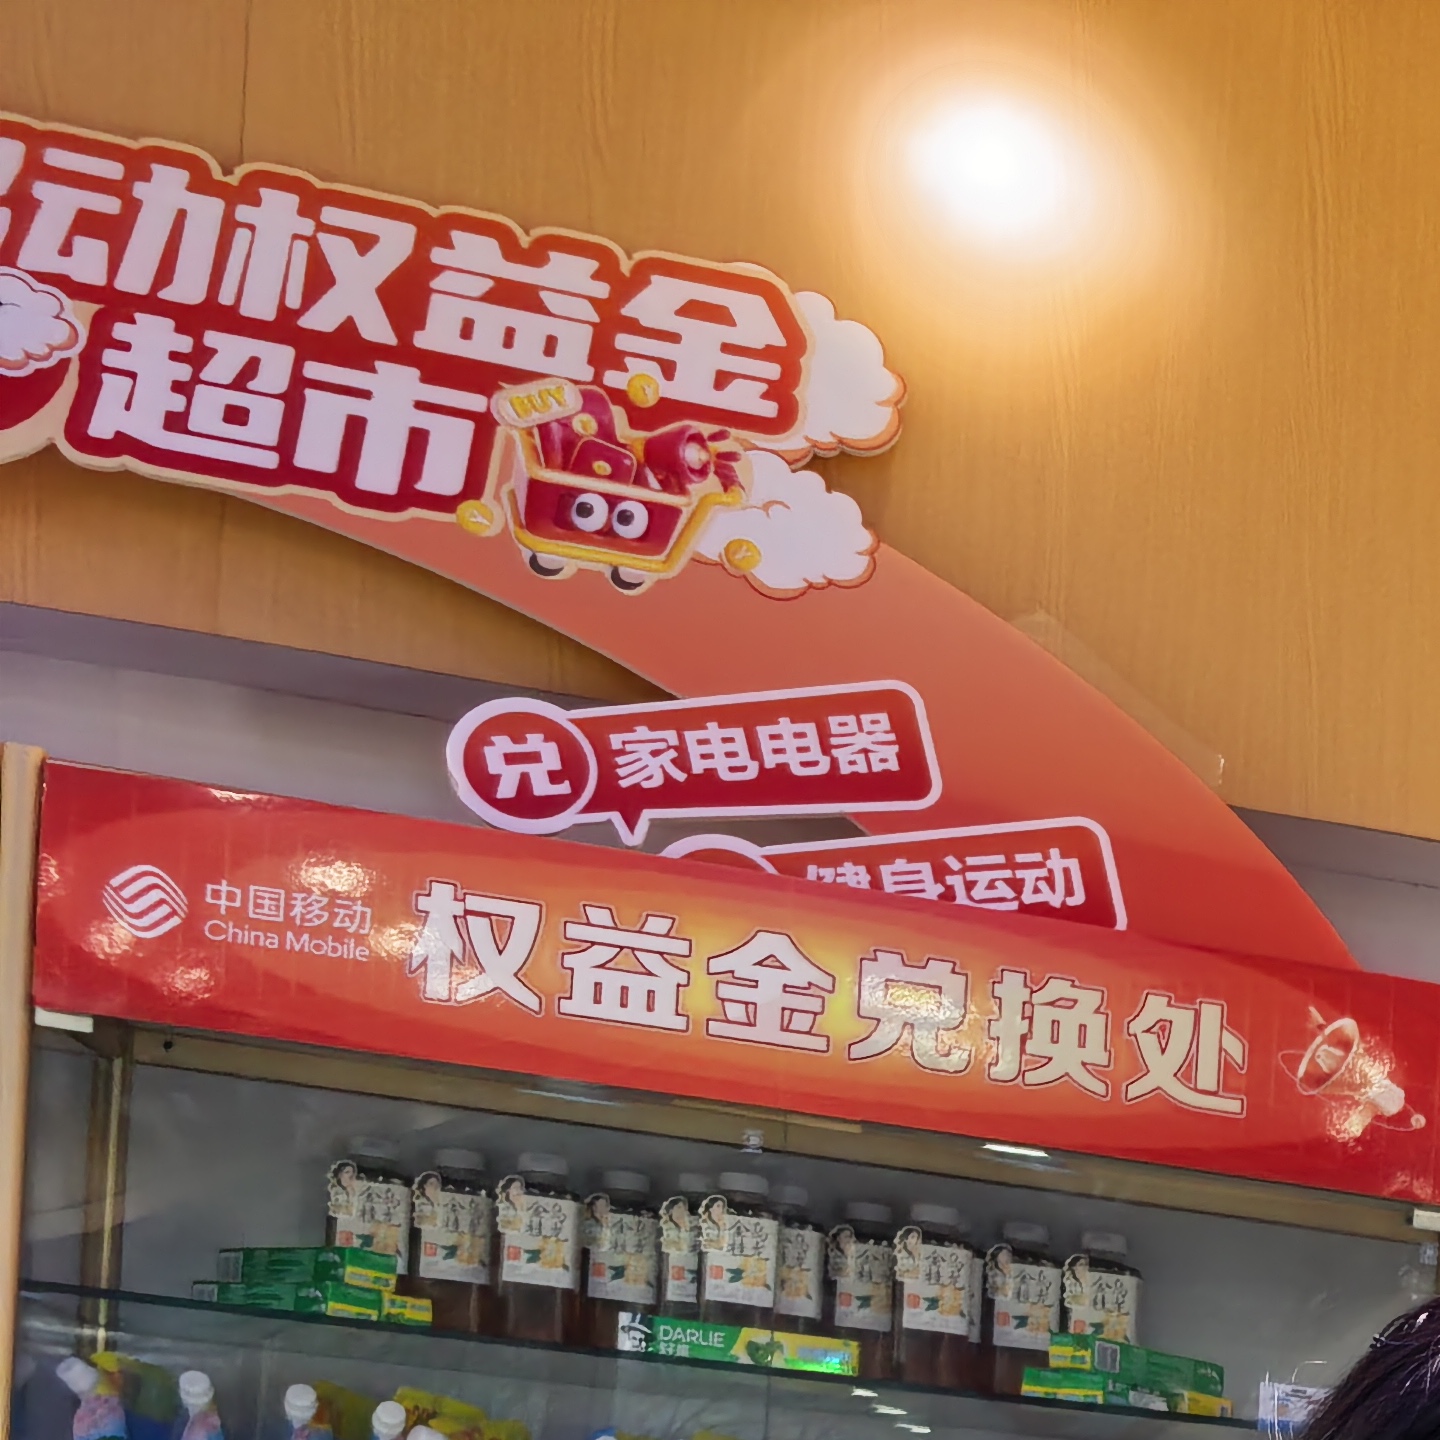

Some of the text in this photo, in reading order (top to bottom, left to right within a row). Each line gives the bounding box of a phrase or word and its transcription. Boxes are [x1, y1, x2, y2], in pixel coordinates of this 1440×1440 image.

[0, 138, 787, 418] 运动权益金
[86, 312, 492, 496] 超市
[508, 382, 569, 419] BUY
[484, 732, 572, 799] 兑
[609, 712, 900, 789] 家电电器
[204, 919, 369, 962] China Mobile
[205, 879, 372, 935] 中国移动
[406, 877, 1247, 1118] 权益金兑换处
[659, 1324, 726, 1348] DARLIE
